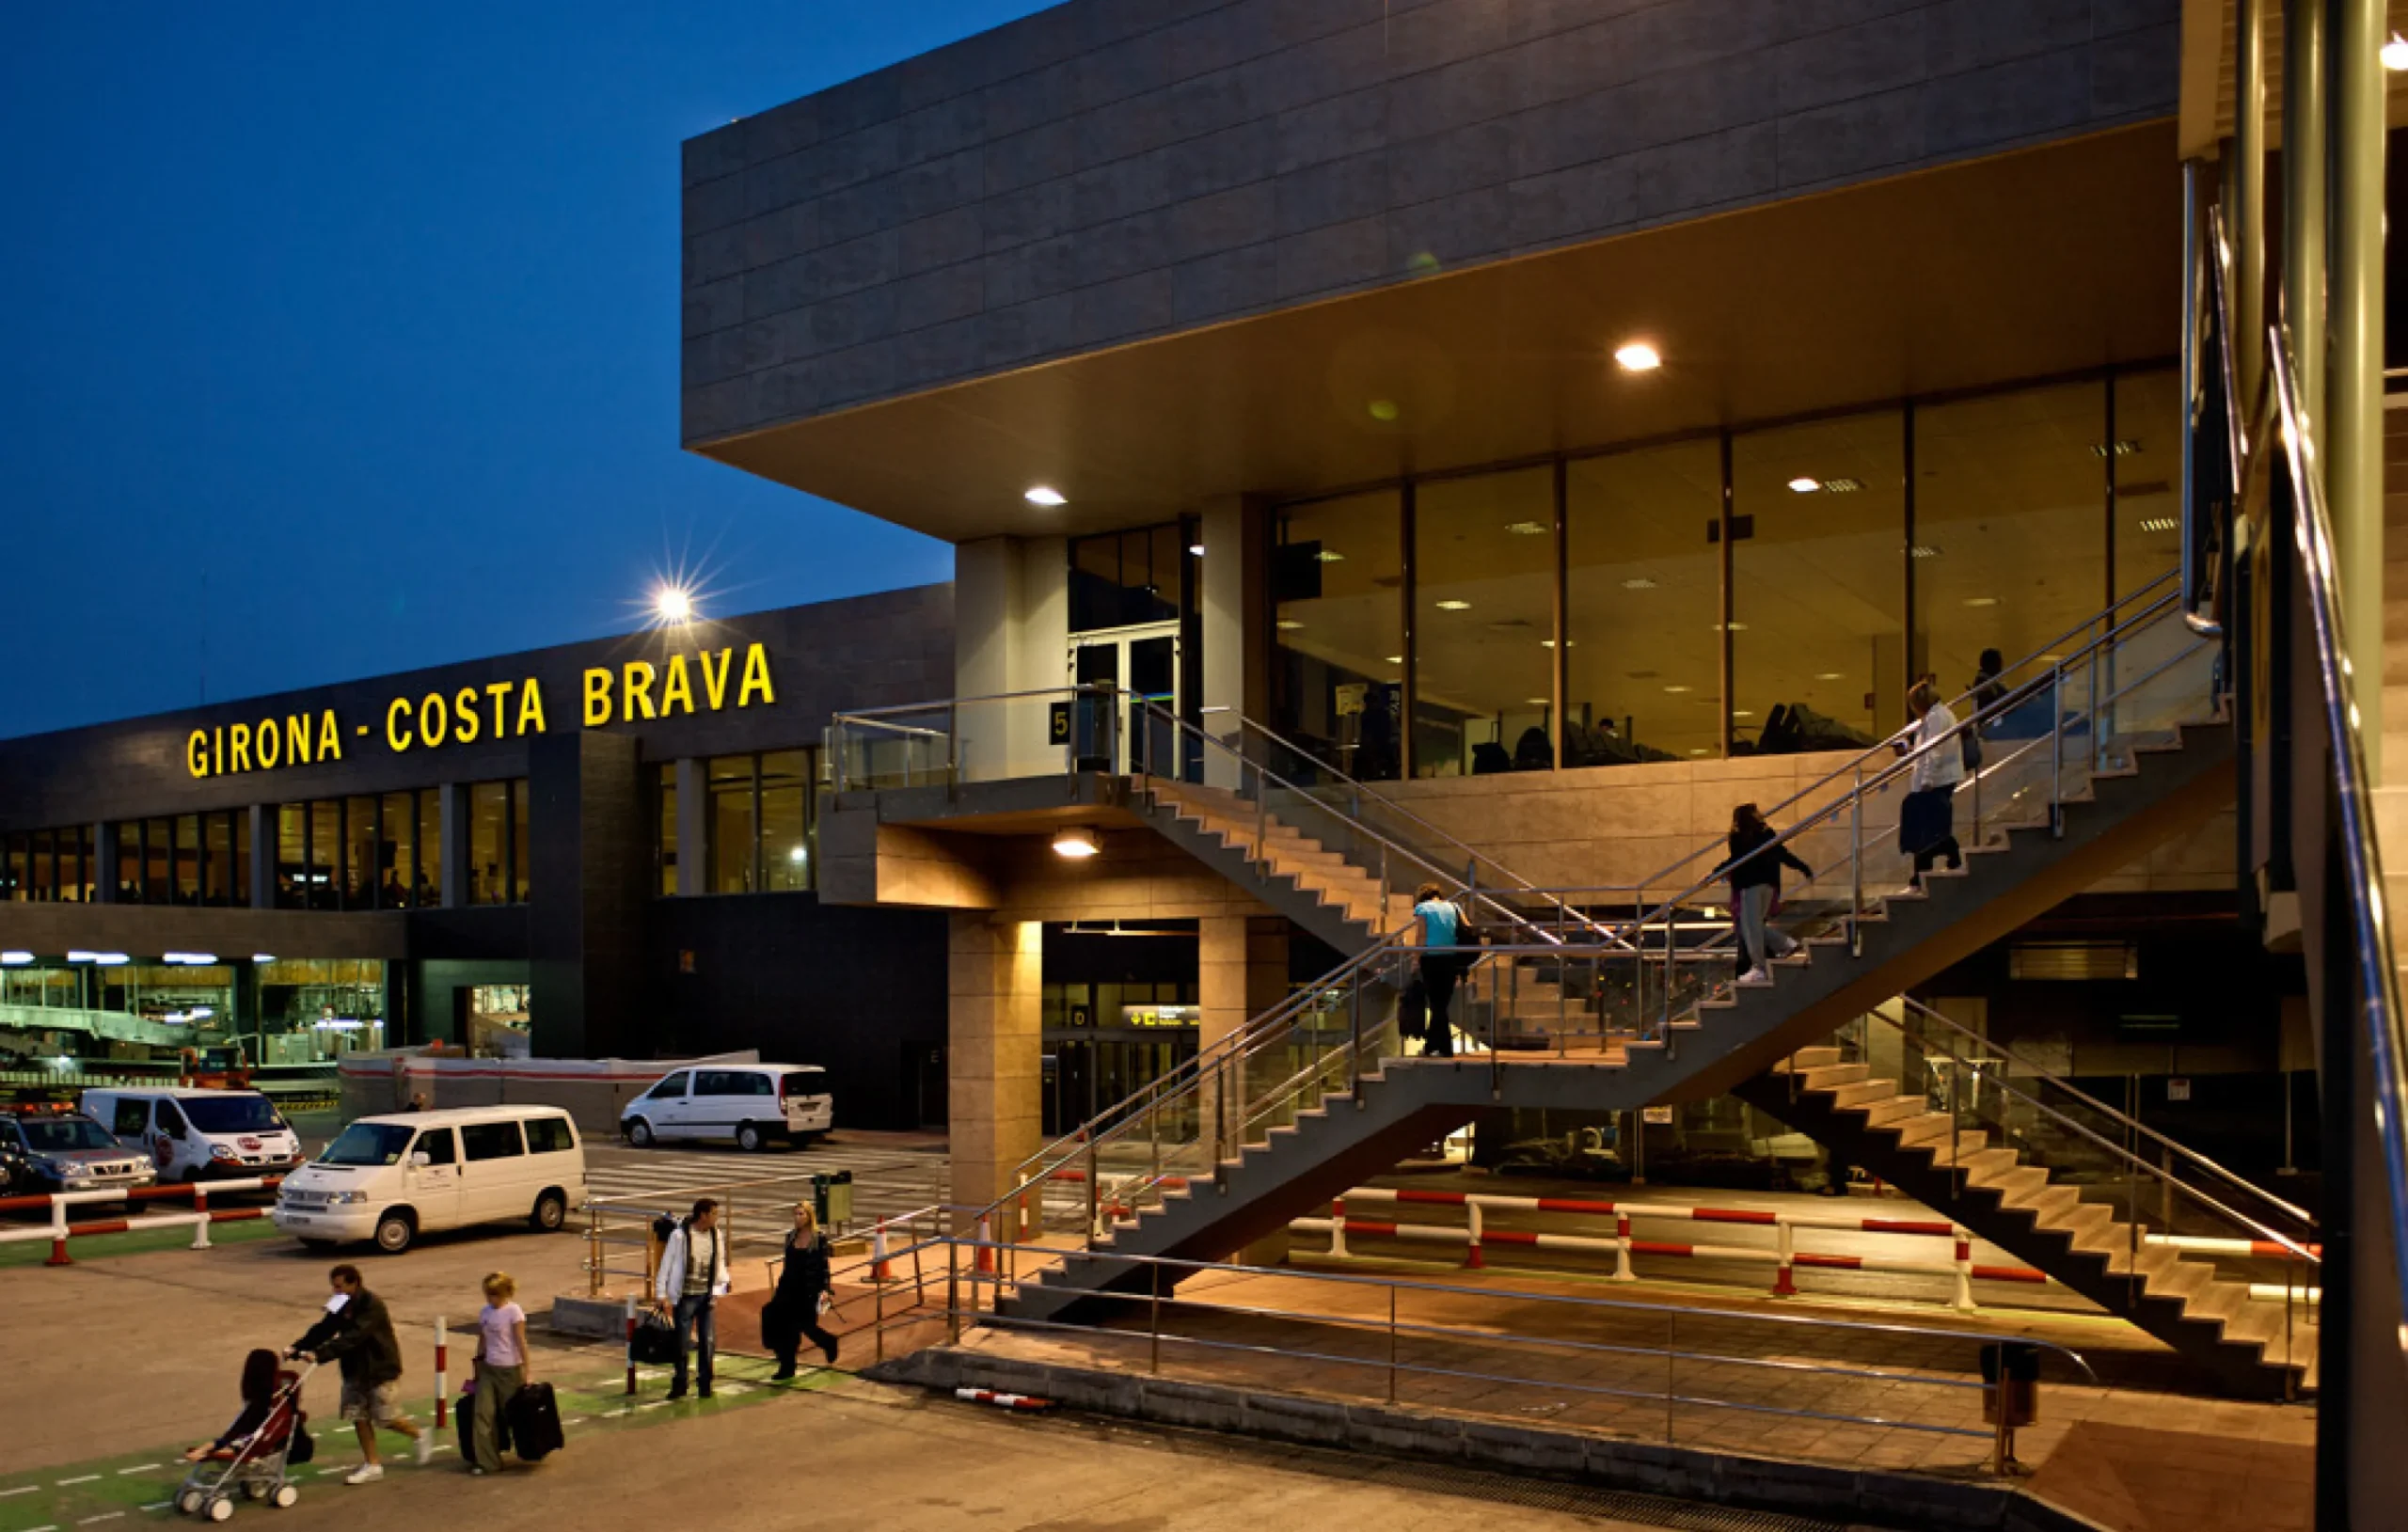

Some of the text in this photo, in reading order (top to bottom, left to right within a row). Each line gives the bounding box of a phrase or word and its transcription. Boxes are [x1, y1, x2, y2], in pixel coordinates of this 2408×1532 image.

[187, 709, 342, 779] GIRONA
[387, 678, 547, 751] COSTA
[584, 642, 774, 727] BRAVA
[1054, 711, 1069, 736] 5
